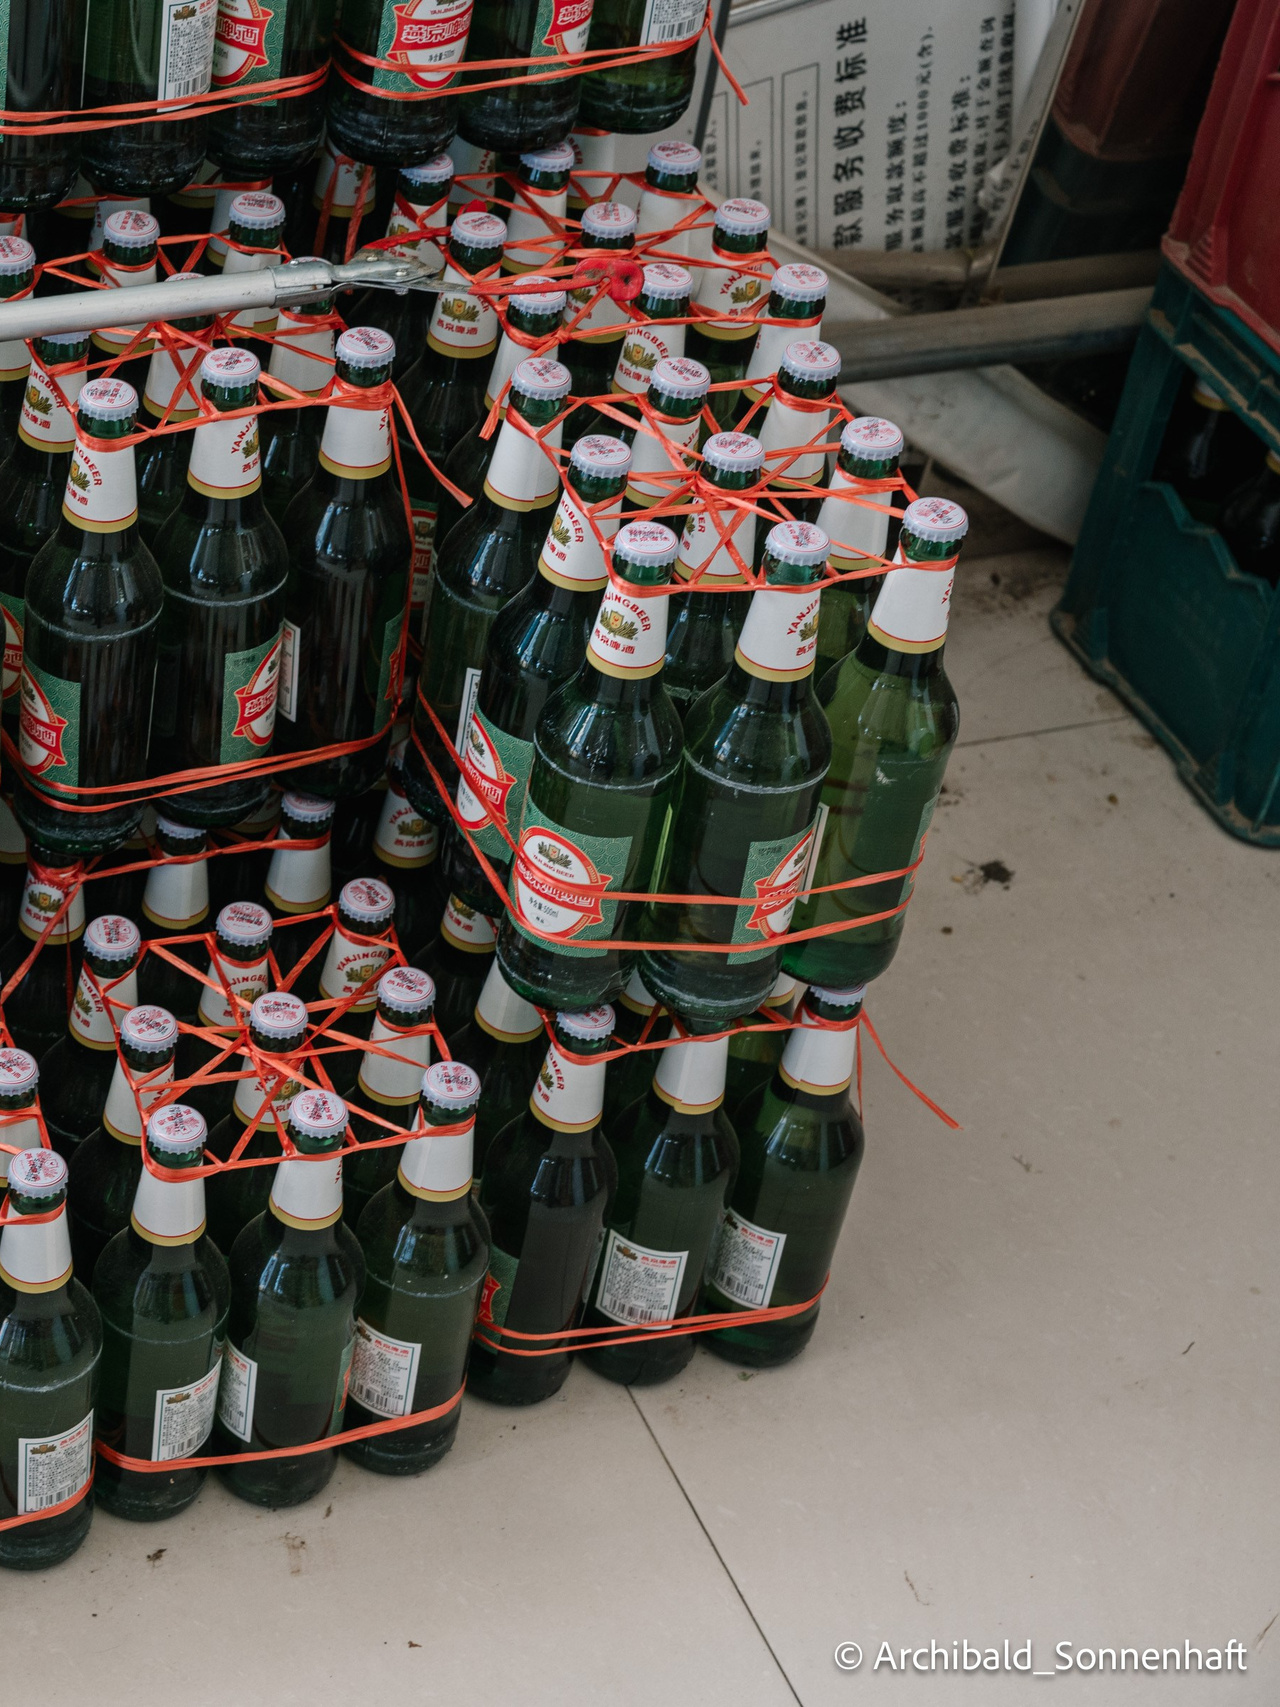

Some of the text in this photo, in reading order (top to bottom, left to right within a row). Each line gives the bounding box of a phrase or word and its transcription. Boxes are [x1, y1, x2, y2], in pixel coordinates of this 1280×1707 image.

[832, 16, 868, 250] 款服务收费标准
